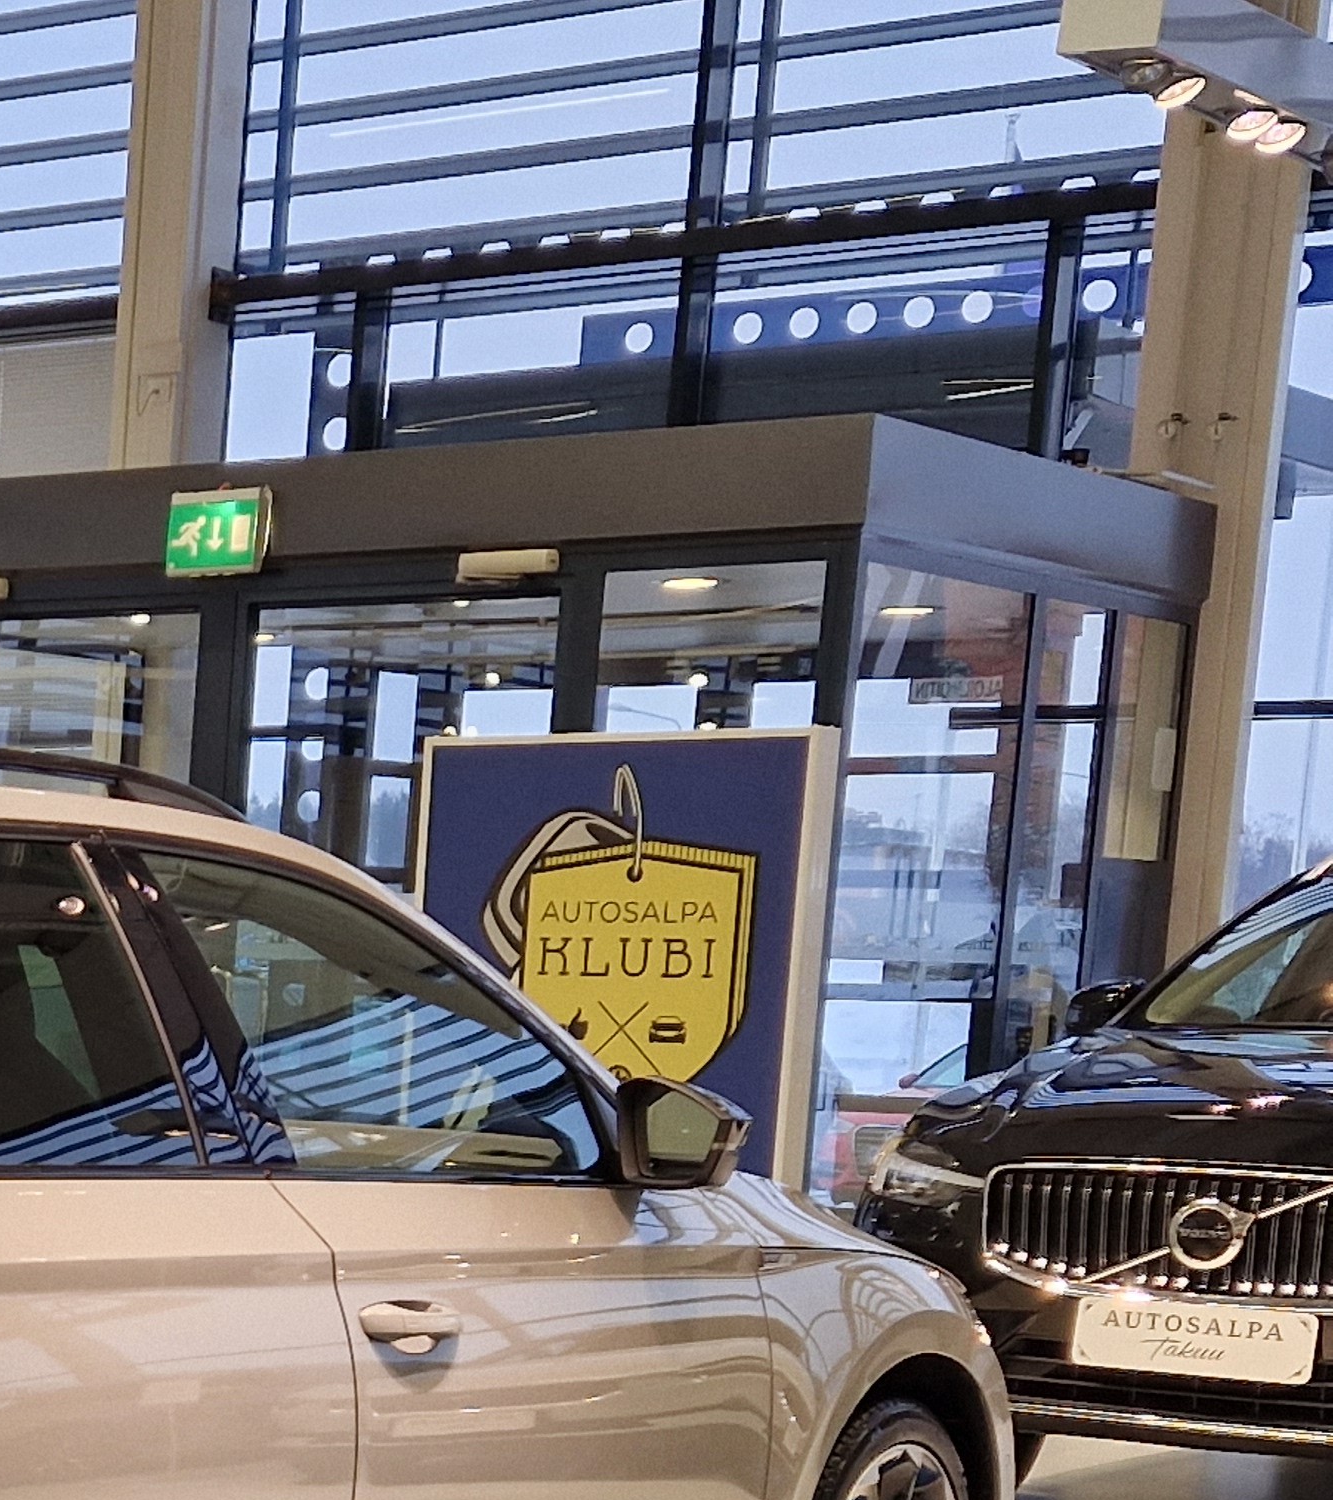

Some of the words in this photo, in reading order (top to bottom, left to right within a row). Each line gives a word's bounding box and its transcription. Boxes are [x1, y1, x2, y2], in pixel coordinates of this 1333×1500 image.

[540, 900, 719, 925] AUTOSALPA
[536, 936, 717, 979] KLUBI
[1101, 1309, 1284, 1342] AUTOSALPA
[1139, 1337, 1226, 1361] Takuu
